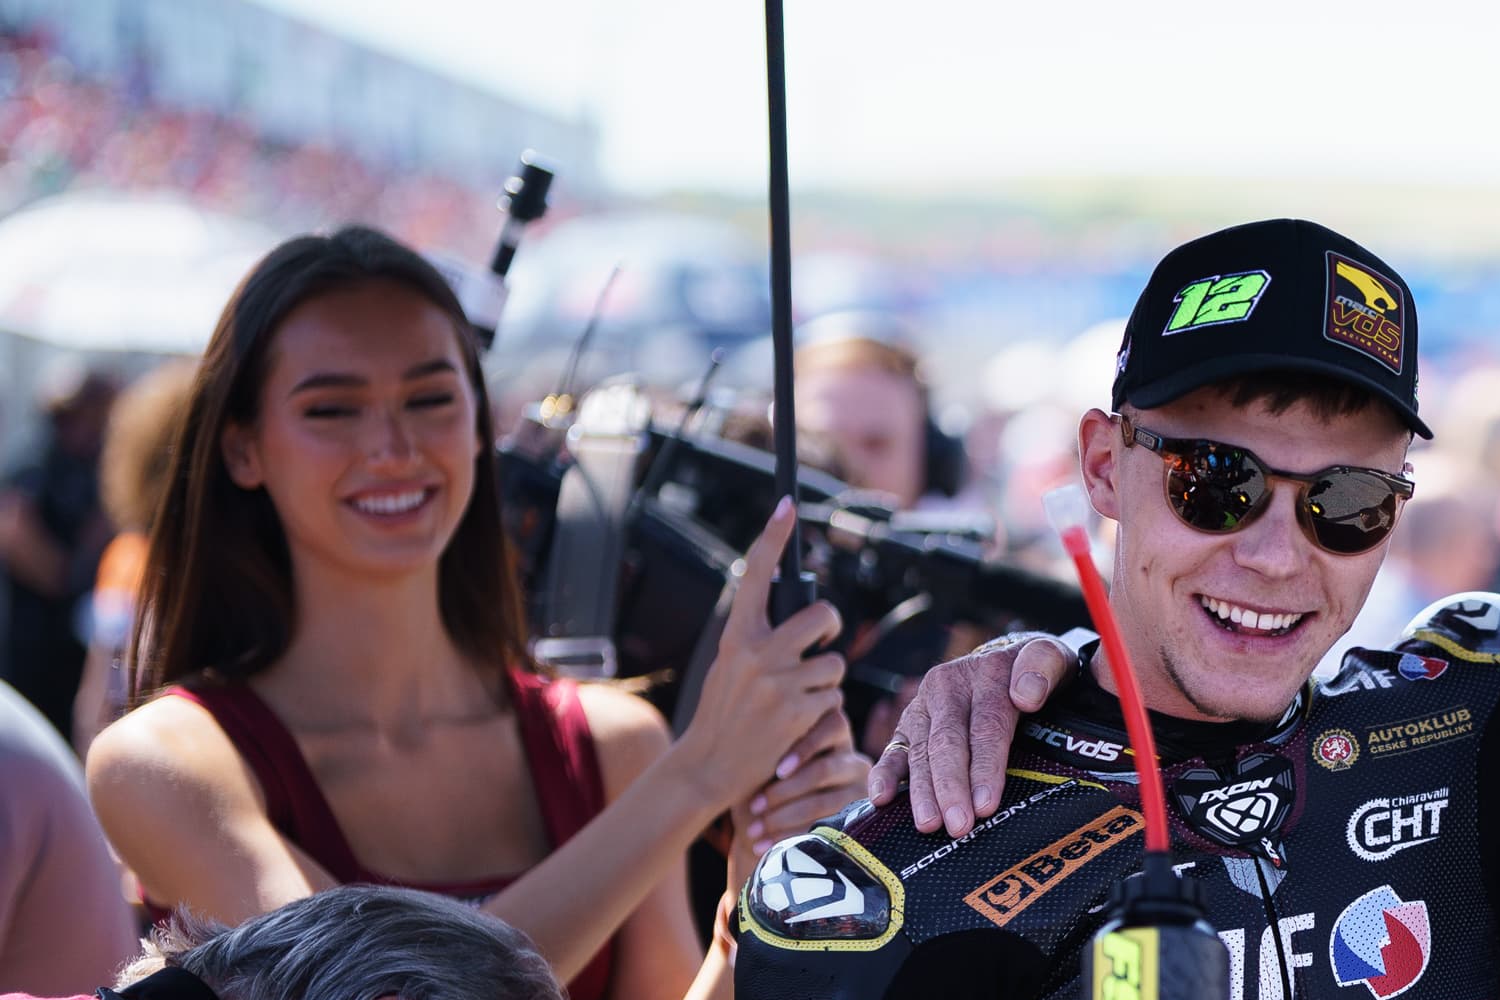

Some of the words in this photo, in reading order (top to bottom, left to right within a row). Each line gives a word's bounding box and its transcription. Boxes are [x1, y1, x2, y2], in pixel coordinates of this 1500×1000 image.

[1164, 271, 1270, 334] 12
[1367, 708, 1472, 745] AUTOKLUB
[1411, 722, 1474, 746] REPUBLIKY
[1199, 776, 1274, 804] IXON
[1391, 786, 1450, 808] Chiaravalli
[901, 799, 1026, 880] SCORPION
[1364, 798, 1449, 847] CHT
[1030, 810, 1139, 882] Beta
